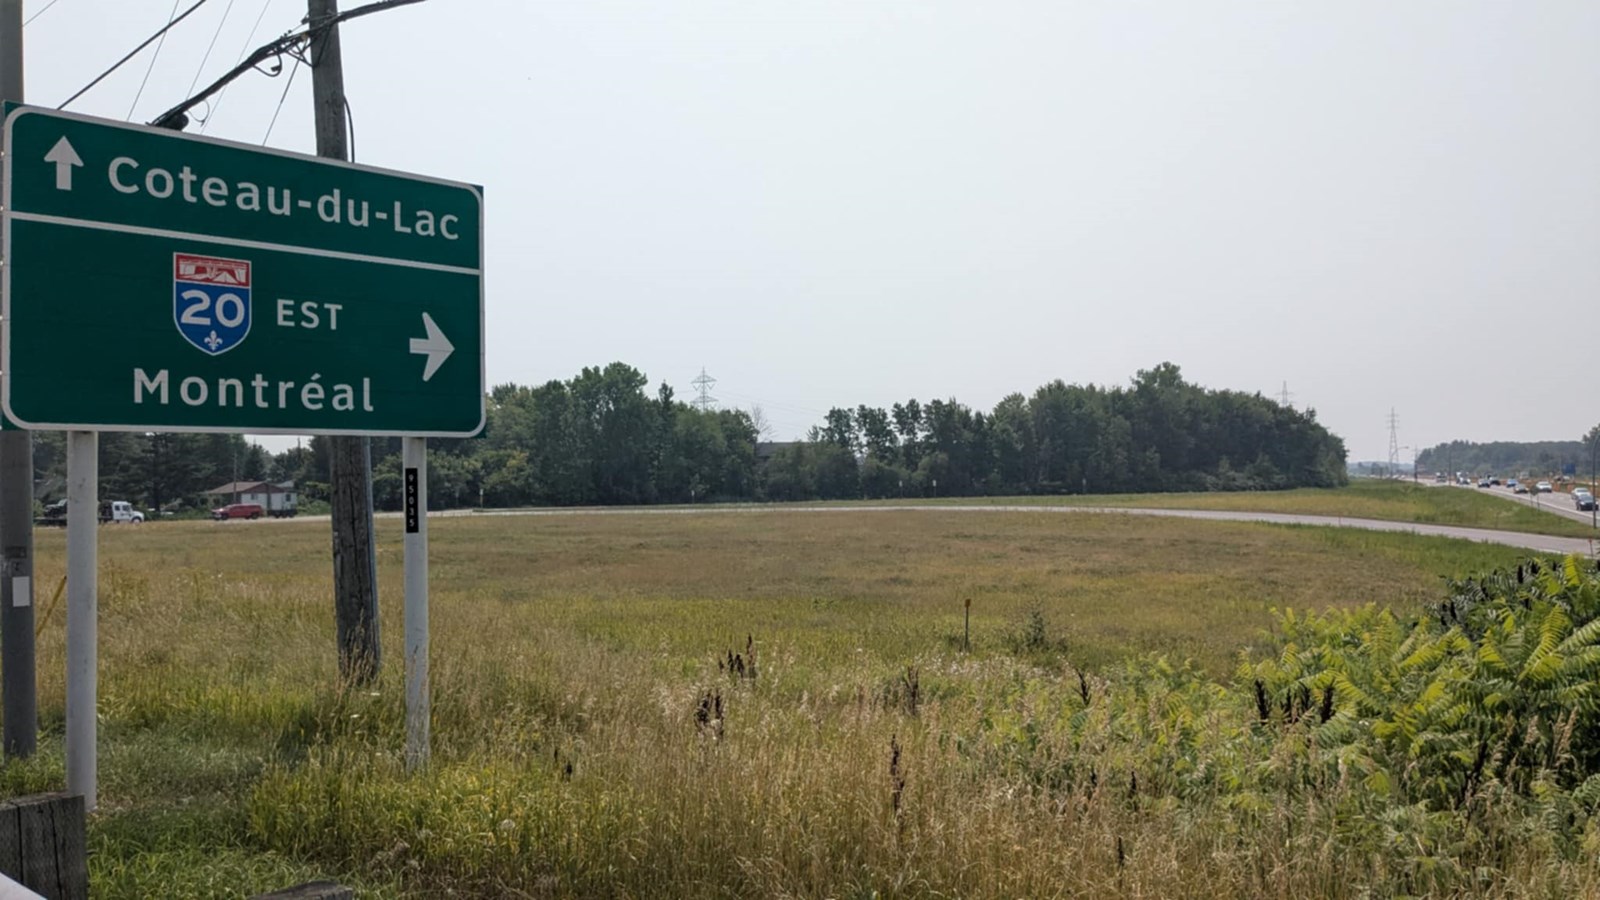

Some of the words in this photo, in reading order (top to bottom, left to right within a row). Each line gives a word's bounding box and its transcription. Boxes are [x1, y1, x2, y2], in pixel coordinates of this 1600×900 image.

[108, 157, 459, 240] Coteau-du-Lac
[180, 289, 245, 328] 20
[277, 299, 343, 330] EST
[134, 368, 374, 412] Montréal
